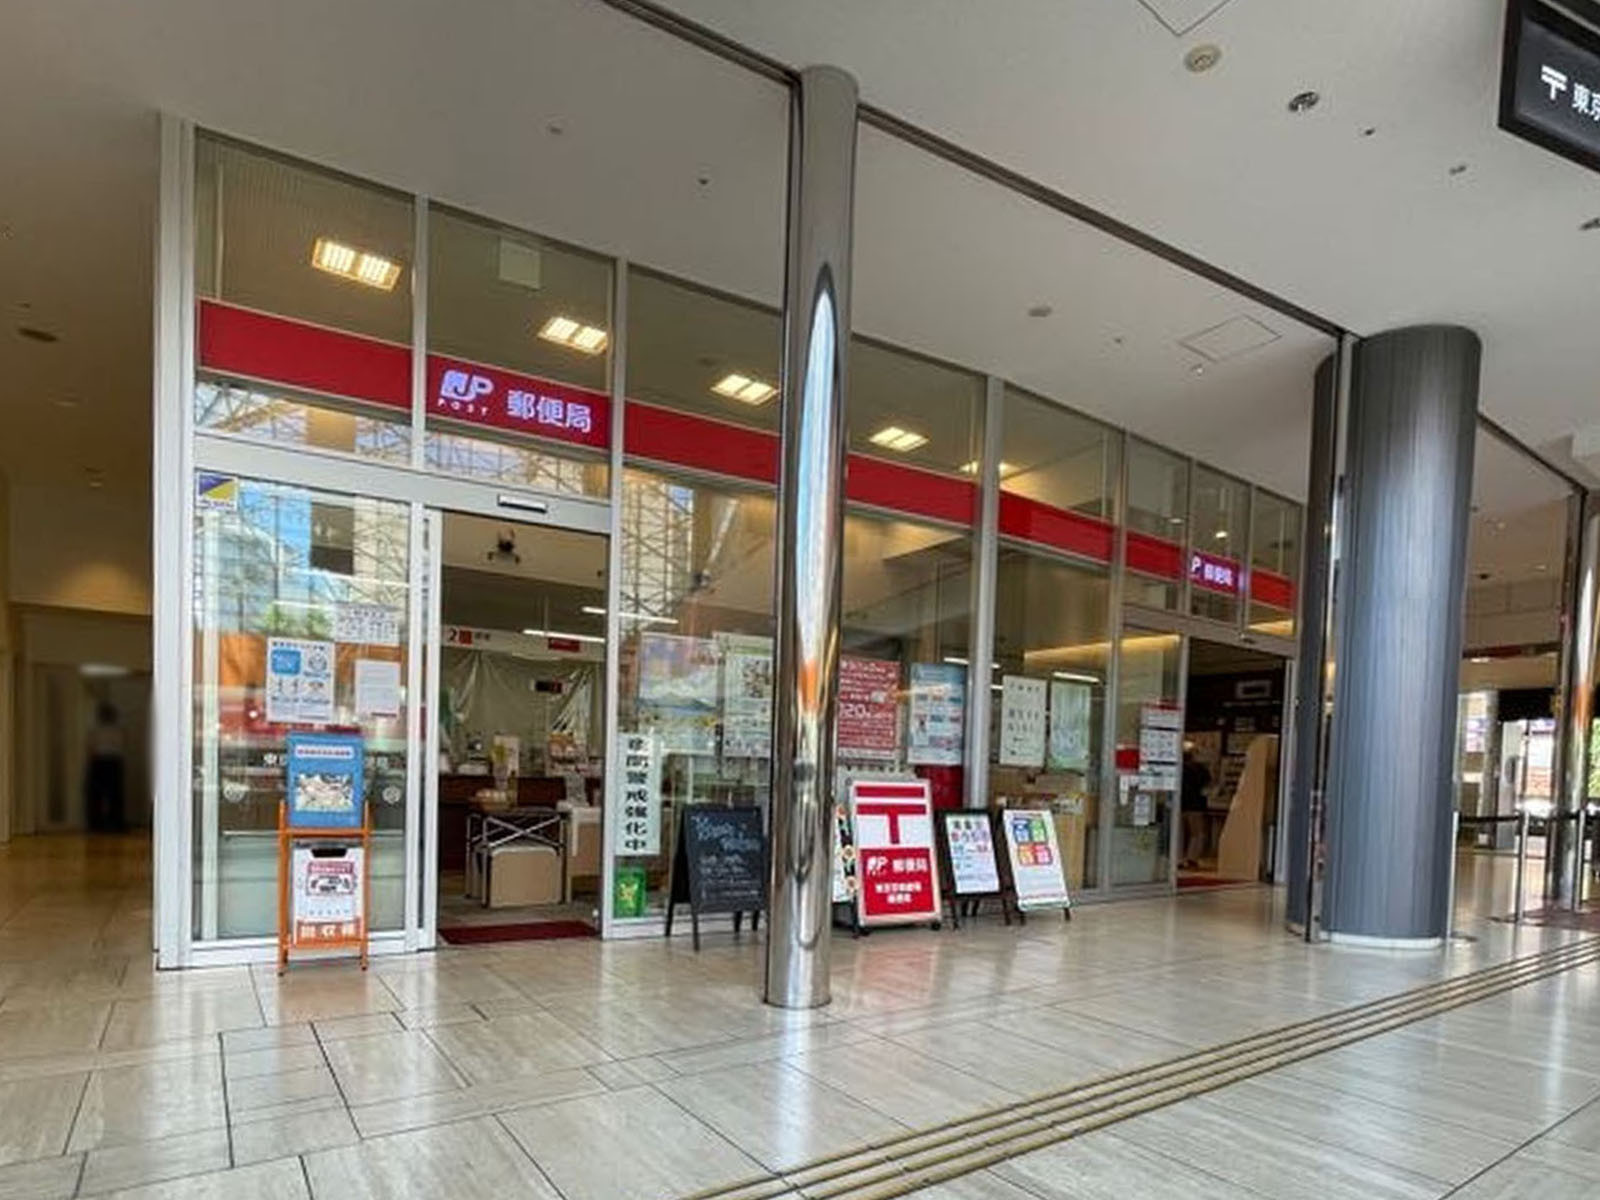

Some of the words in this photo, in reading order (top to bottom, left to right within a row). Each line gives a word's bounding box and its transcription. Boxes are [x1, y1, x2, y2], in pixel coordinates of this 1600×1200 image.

[437, 397, 489, 416] POST
[506, 389, 592, 433] 郵便局
